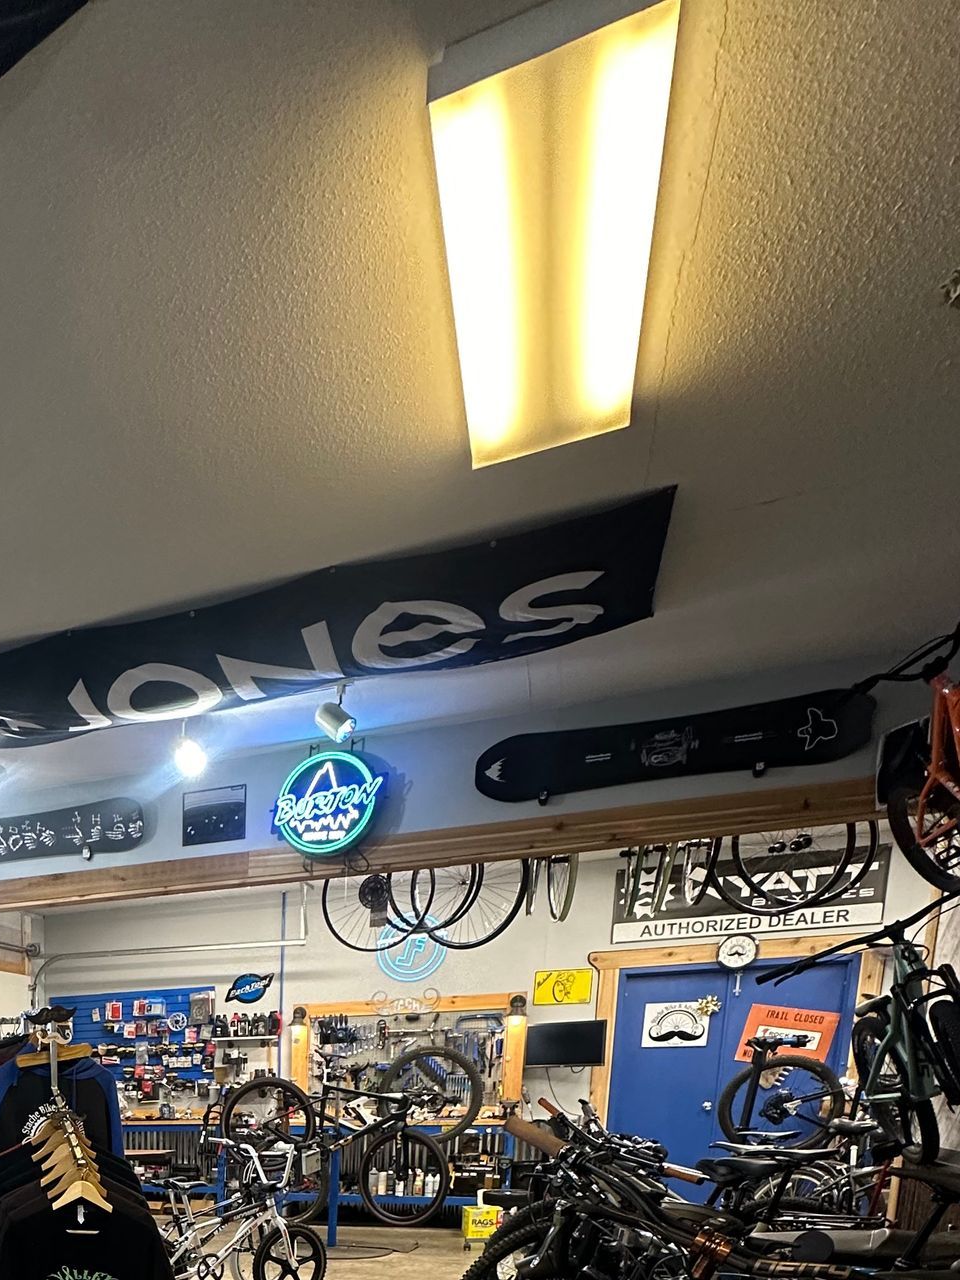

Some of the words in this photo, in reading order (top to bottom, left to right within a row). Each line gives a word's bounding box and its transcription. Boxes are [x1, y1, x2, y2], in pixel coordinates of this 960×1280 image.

[639, 914, 762, 938] AUTHORIZED
[768, 909, 850, 928] DEALER
[766, 1009, 789, 1021] TRAIL
[794, 1012, 825, 1025] CLOSED
[22, 1111, 40, 1135] Stache
[39, 1103, 58, 1114] Bike
[471, 1218, 495, 1226] RAGS
[752, 1258, 851, 1279] DEITY
